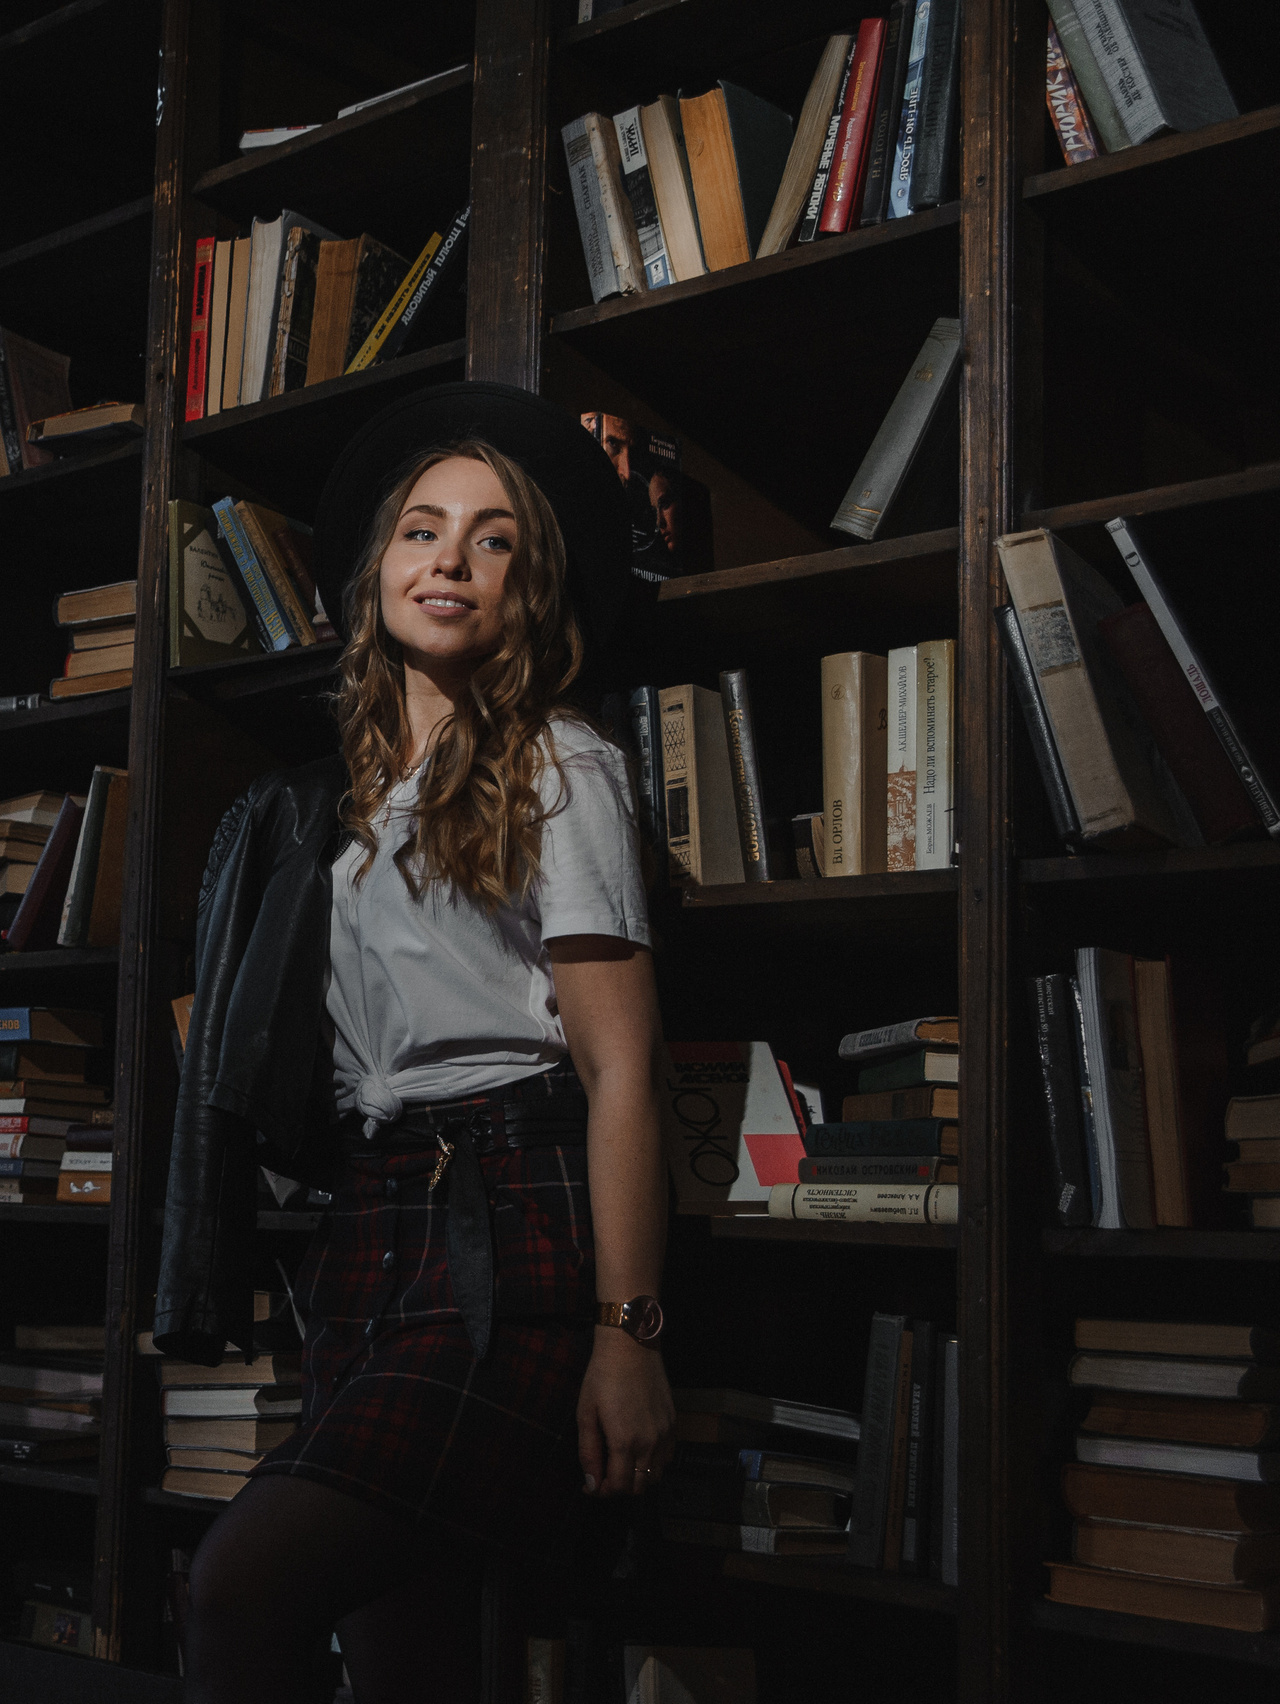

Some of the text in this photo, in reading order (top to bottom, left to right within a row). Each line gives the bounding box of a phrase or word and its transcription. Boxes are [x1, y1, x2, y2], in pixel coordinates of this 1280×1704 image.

[1095, 21, 1113, 56] ЛЕГЕНДА
[1109, 40, 1120, 53] ОБ
[1117, 55, 1141, 101] ДЕ КОСТЕР
[1117, 77, 1134, 107] ШАРЛЬ
[844, 116, 856, 141] Роддом.
[874, 108, 889, 153] ГОГОЛЬ
[898, 85, 920, 181] ЯРОСТЬ ON-LINE
[1047, 70, 1084, 151] РЮРИК
[817, 113, 841, 170] МОЧЕНЫЕ
[578, 163, 591, 209] СПАРТАК
[805, 171, 826, 220] ЯБЛОКИ
[373, 252, 431, 340] КАК НАЗВАТЬ РЕБЕНКА
[399, 226, 462, 326] ЯДОВИТЫЙ ПЛЮЩ
[263, 610, 285, 640] ВСЯ
[1185, 662, 1213, 704] ЛОШАДЬ
[922, 656, 939, 794] Надо ли вспоминать старое?
[727, 708, 762, 862] Константин СИМОНОВ
[1248, 780, 1277, 826] ОЧЕВИДЕЦ
[831, 798, 842, 844] ОРЛОВ
[1034, 976, 1047, 1022] фантастика
[1043, 974, 1055, 1015] Советская
[667, 1079, 740, 1187] ОЖОГ
[806, 1188, 857, 1196] СИСТЕМНОСТЬ
[816, 1164, 917, 1175] НИКОЛАЙ ОСТРОВСКИЙ
[907, 1382, 920, 1507] АНАТОЛИЙ ПРИСТАВКИН
